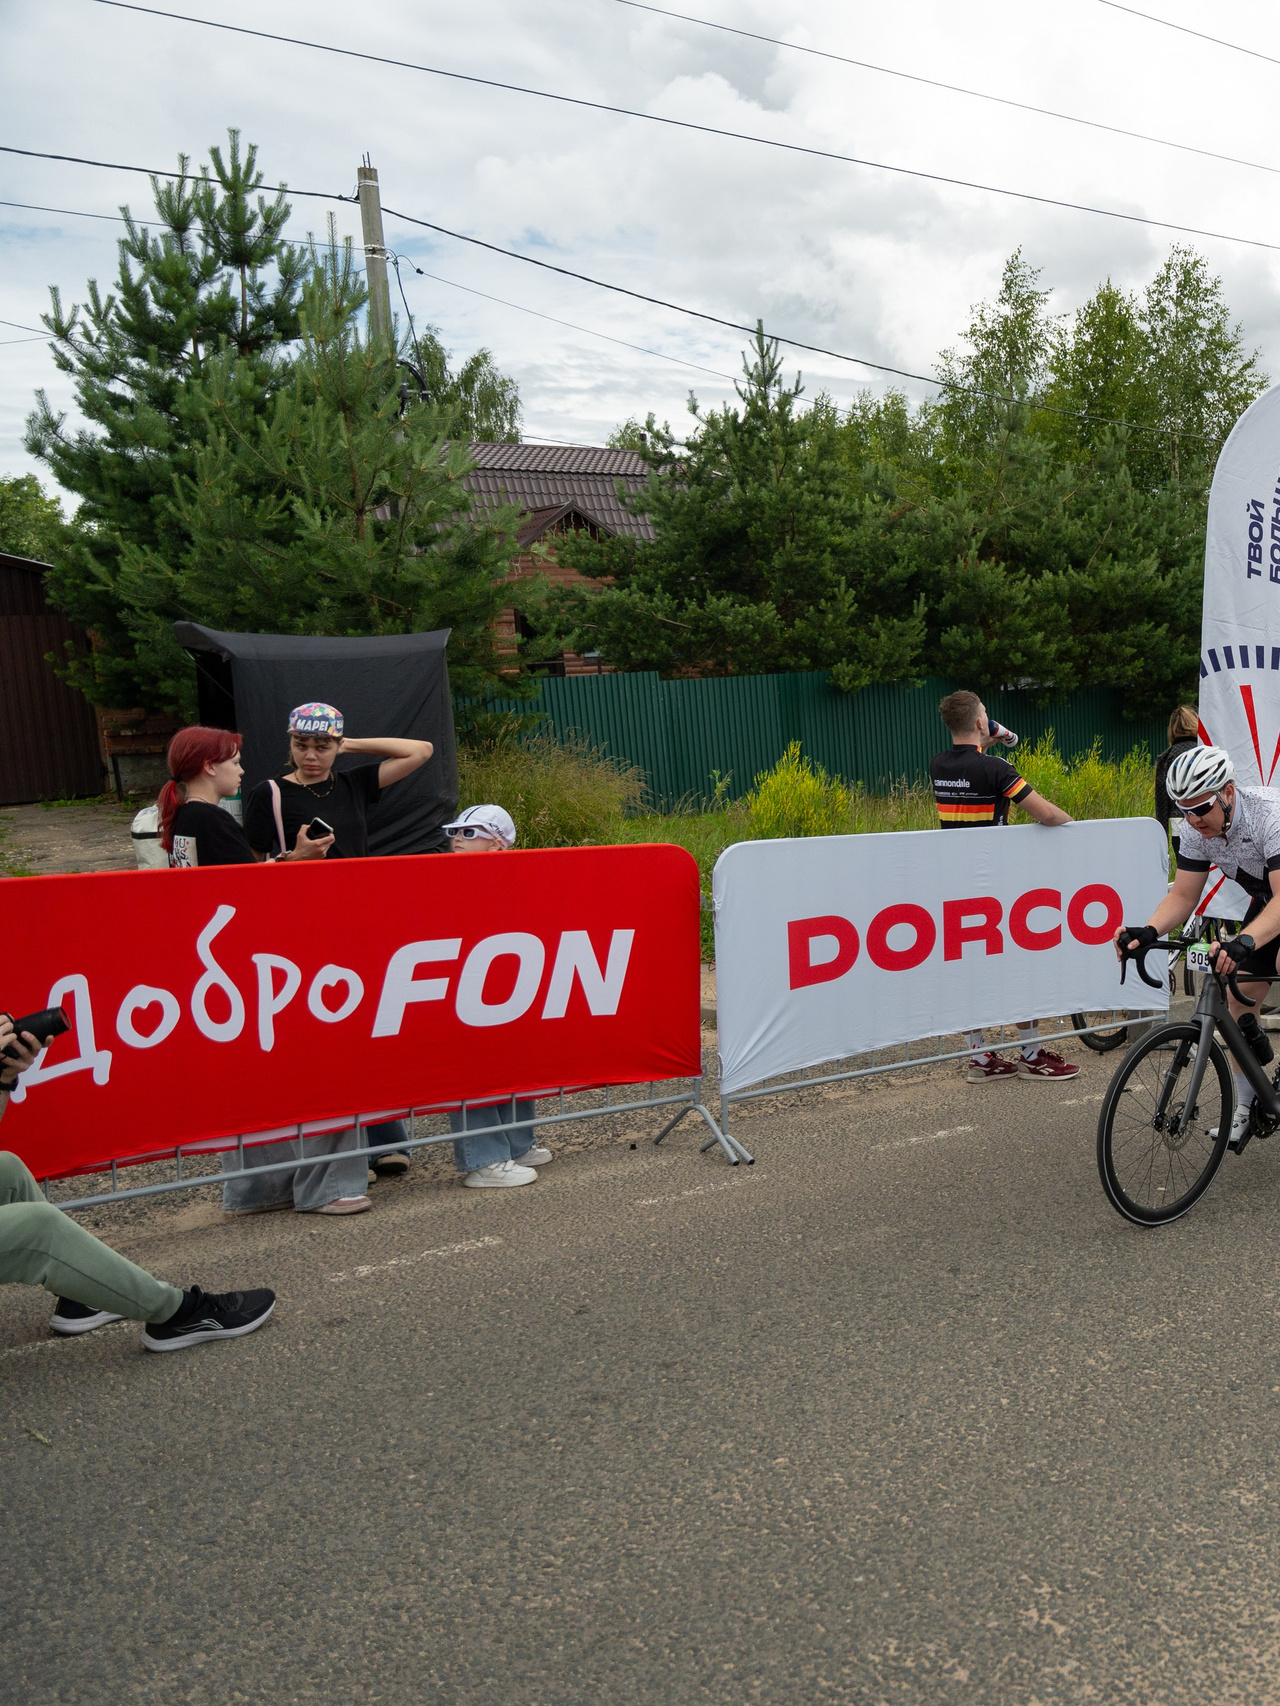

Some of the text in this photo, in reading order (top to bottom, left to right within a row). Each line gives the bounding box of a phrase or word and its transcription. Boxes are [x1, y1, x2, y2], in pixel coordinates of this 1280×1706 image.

[1246, 499, 1265, 579] ТВОЙ
[296, 719, 329, 732] MAPEI
[788, 883, 1124, 990] DORCO
